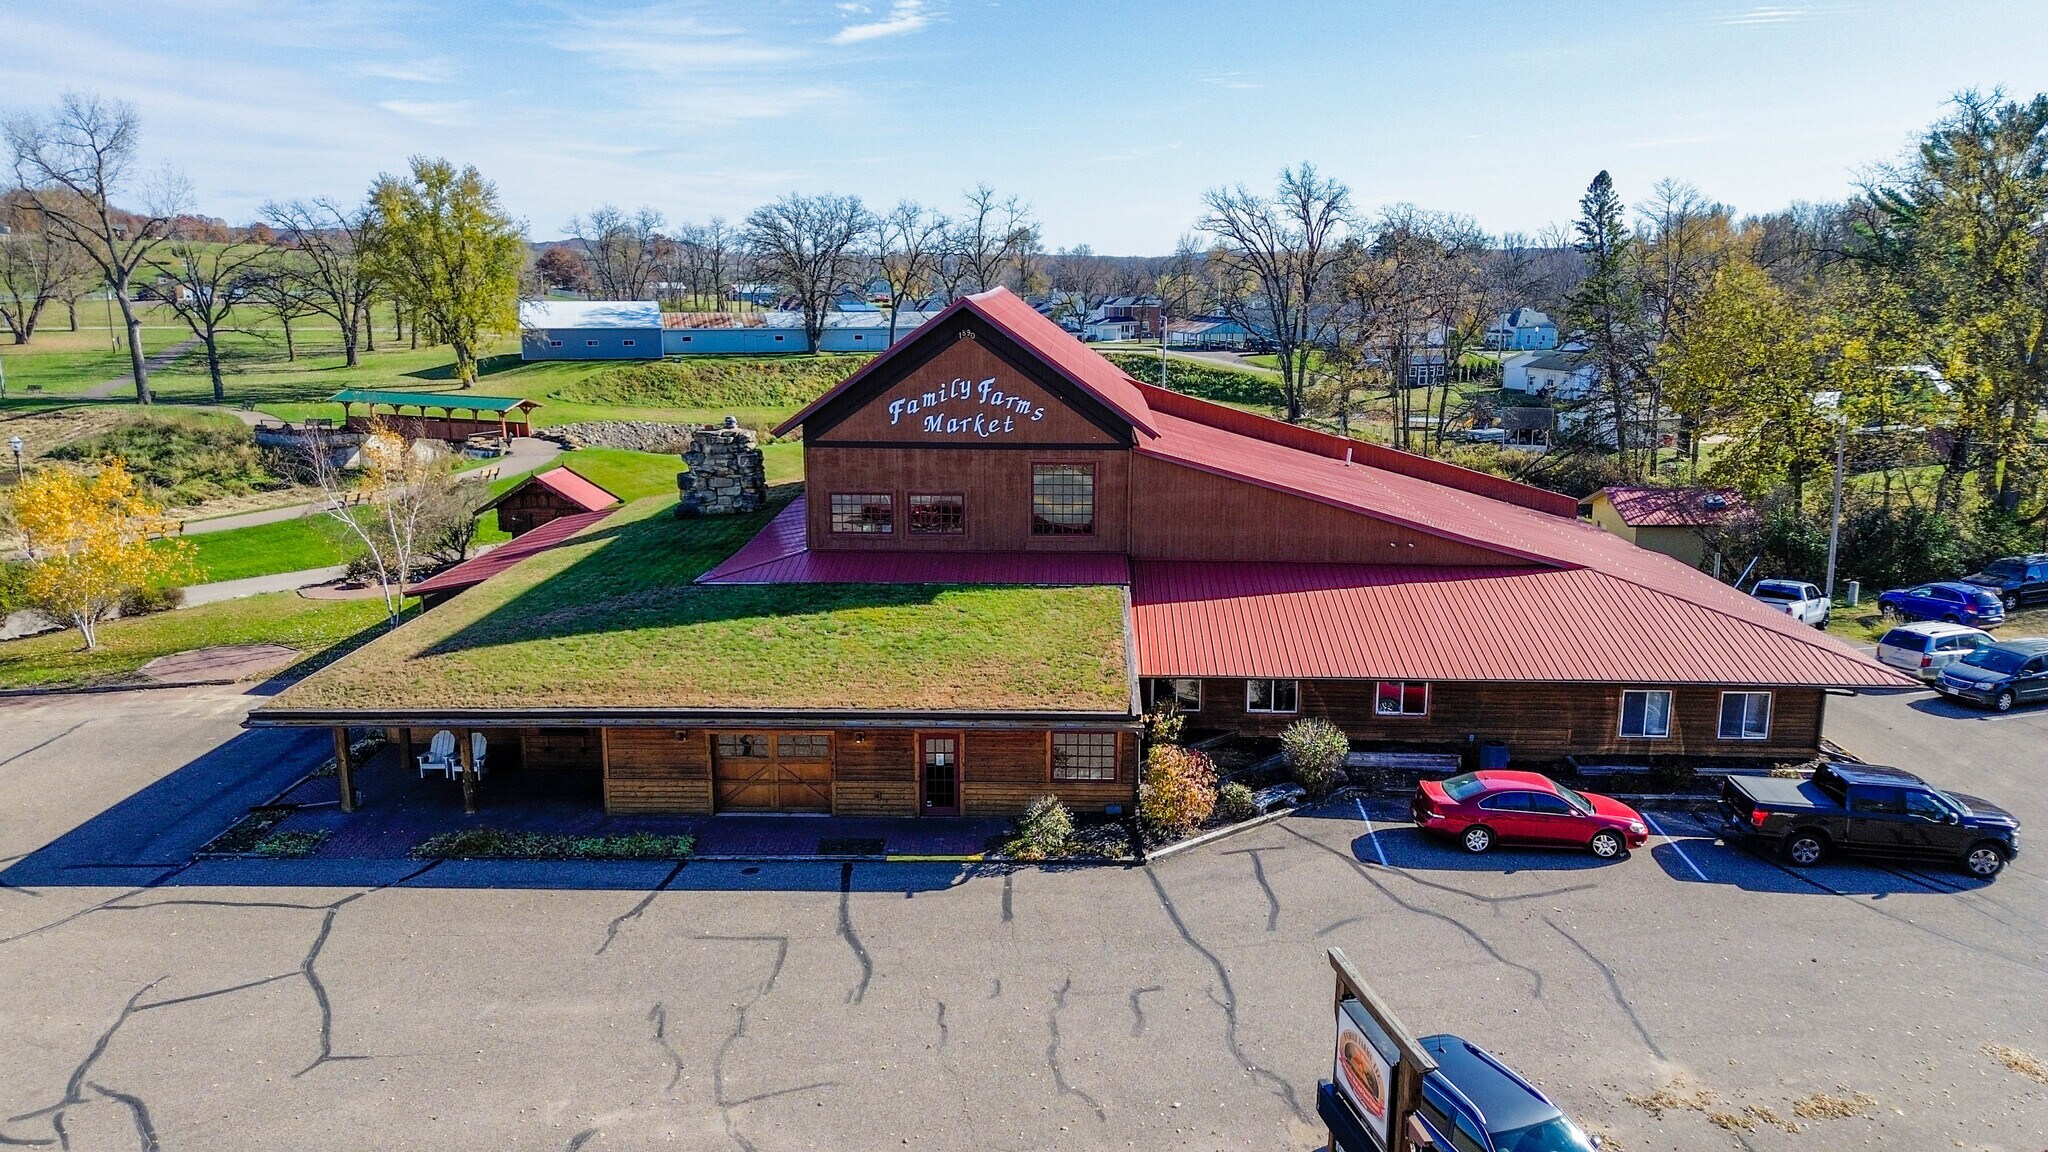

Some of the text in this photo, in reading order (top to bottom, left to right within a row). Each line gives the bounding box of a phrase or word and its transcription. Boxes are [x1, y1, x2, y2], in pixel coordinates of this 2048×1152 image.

[888, 377, 1045, 425] Family Farms
[923, 412, 1014, 438] Market
